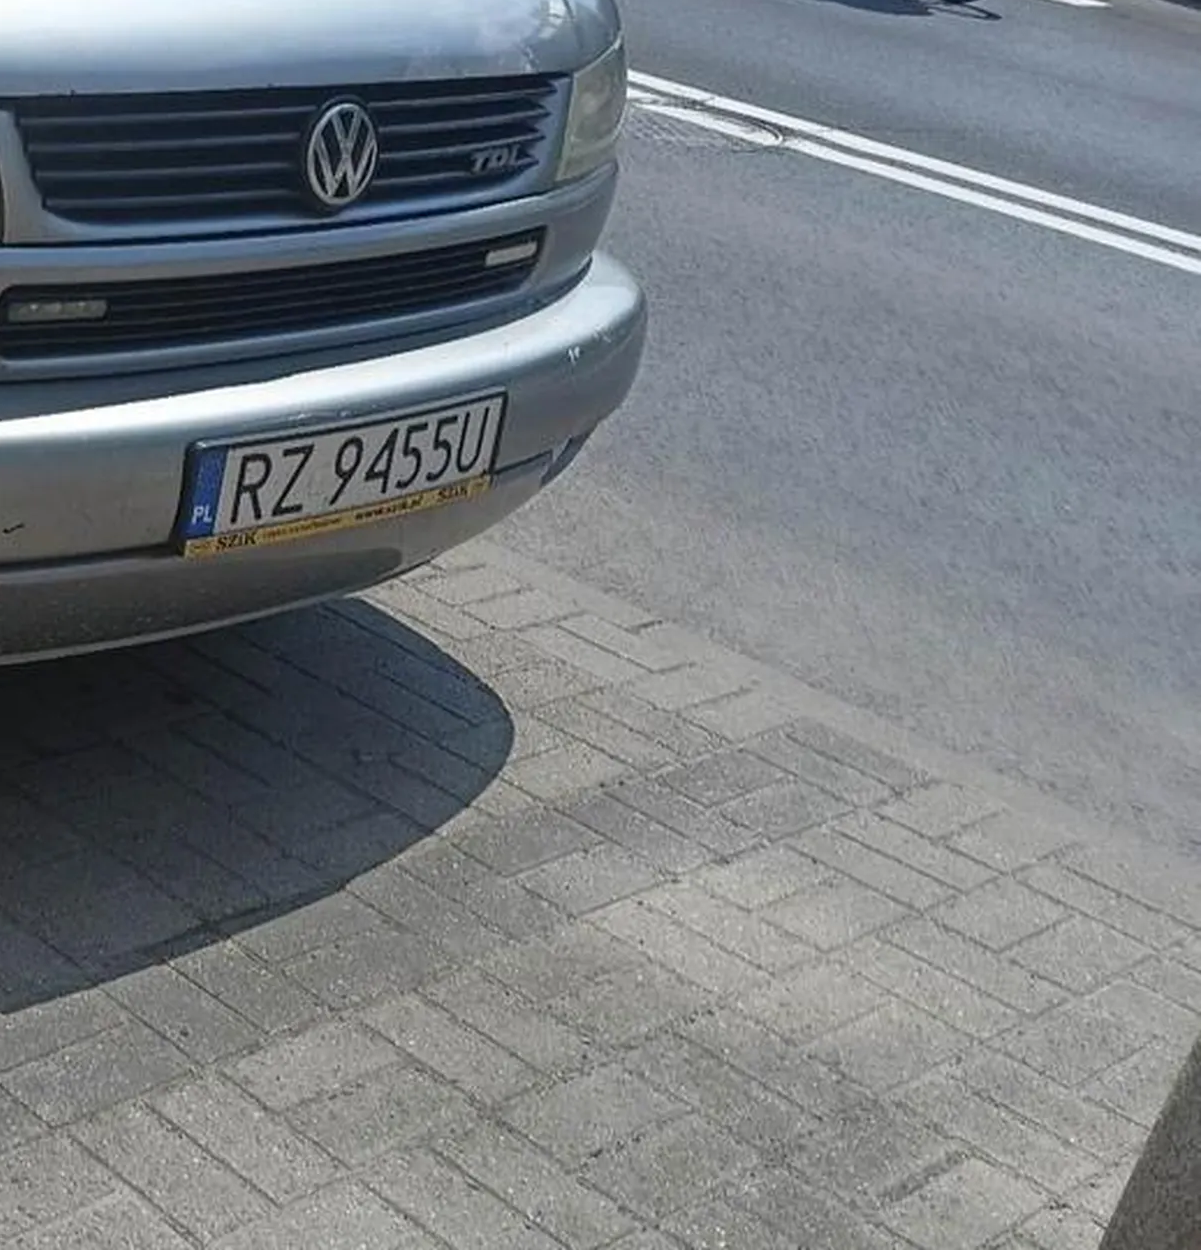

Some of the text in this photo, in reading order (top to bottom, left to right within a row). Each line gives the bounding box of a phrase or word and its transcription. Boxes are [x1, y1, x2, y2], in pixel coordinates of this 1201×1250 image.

[230, 407, 490, 524] RZ 9455U
[191, 504, 213, 525] PL
